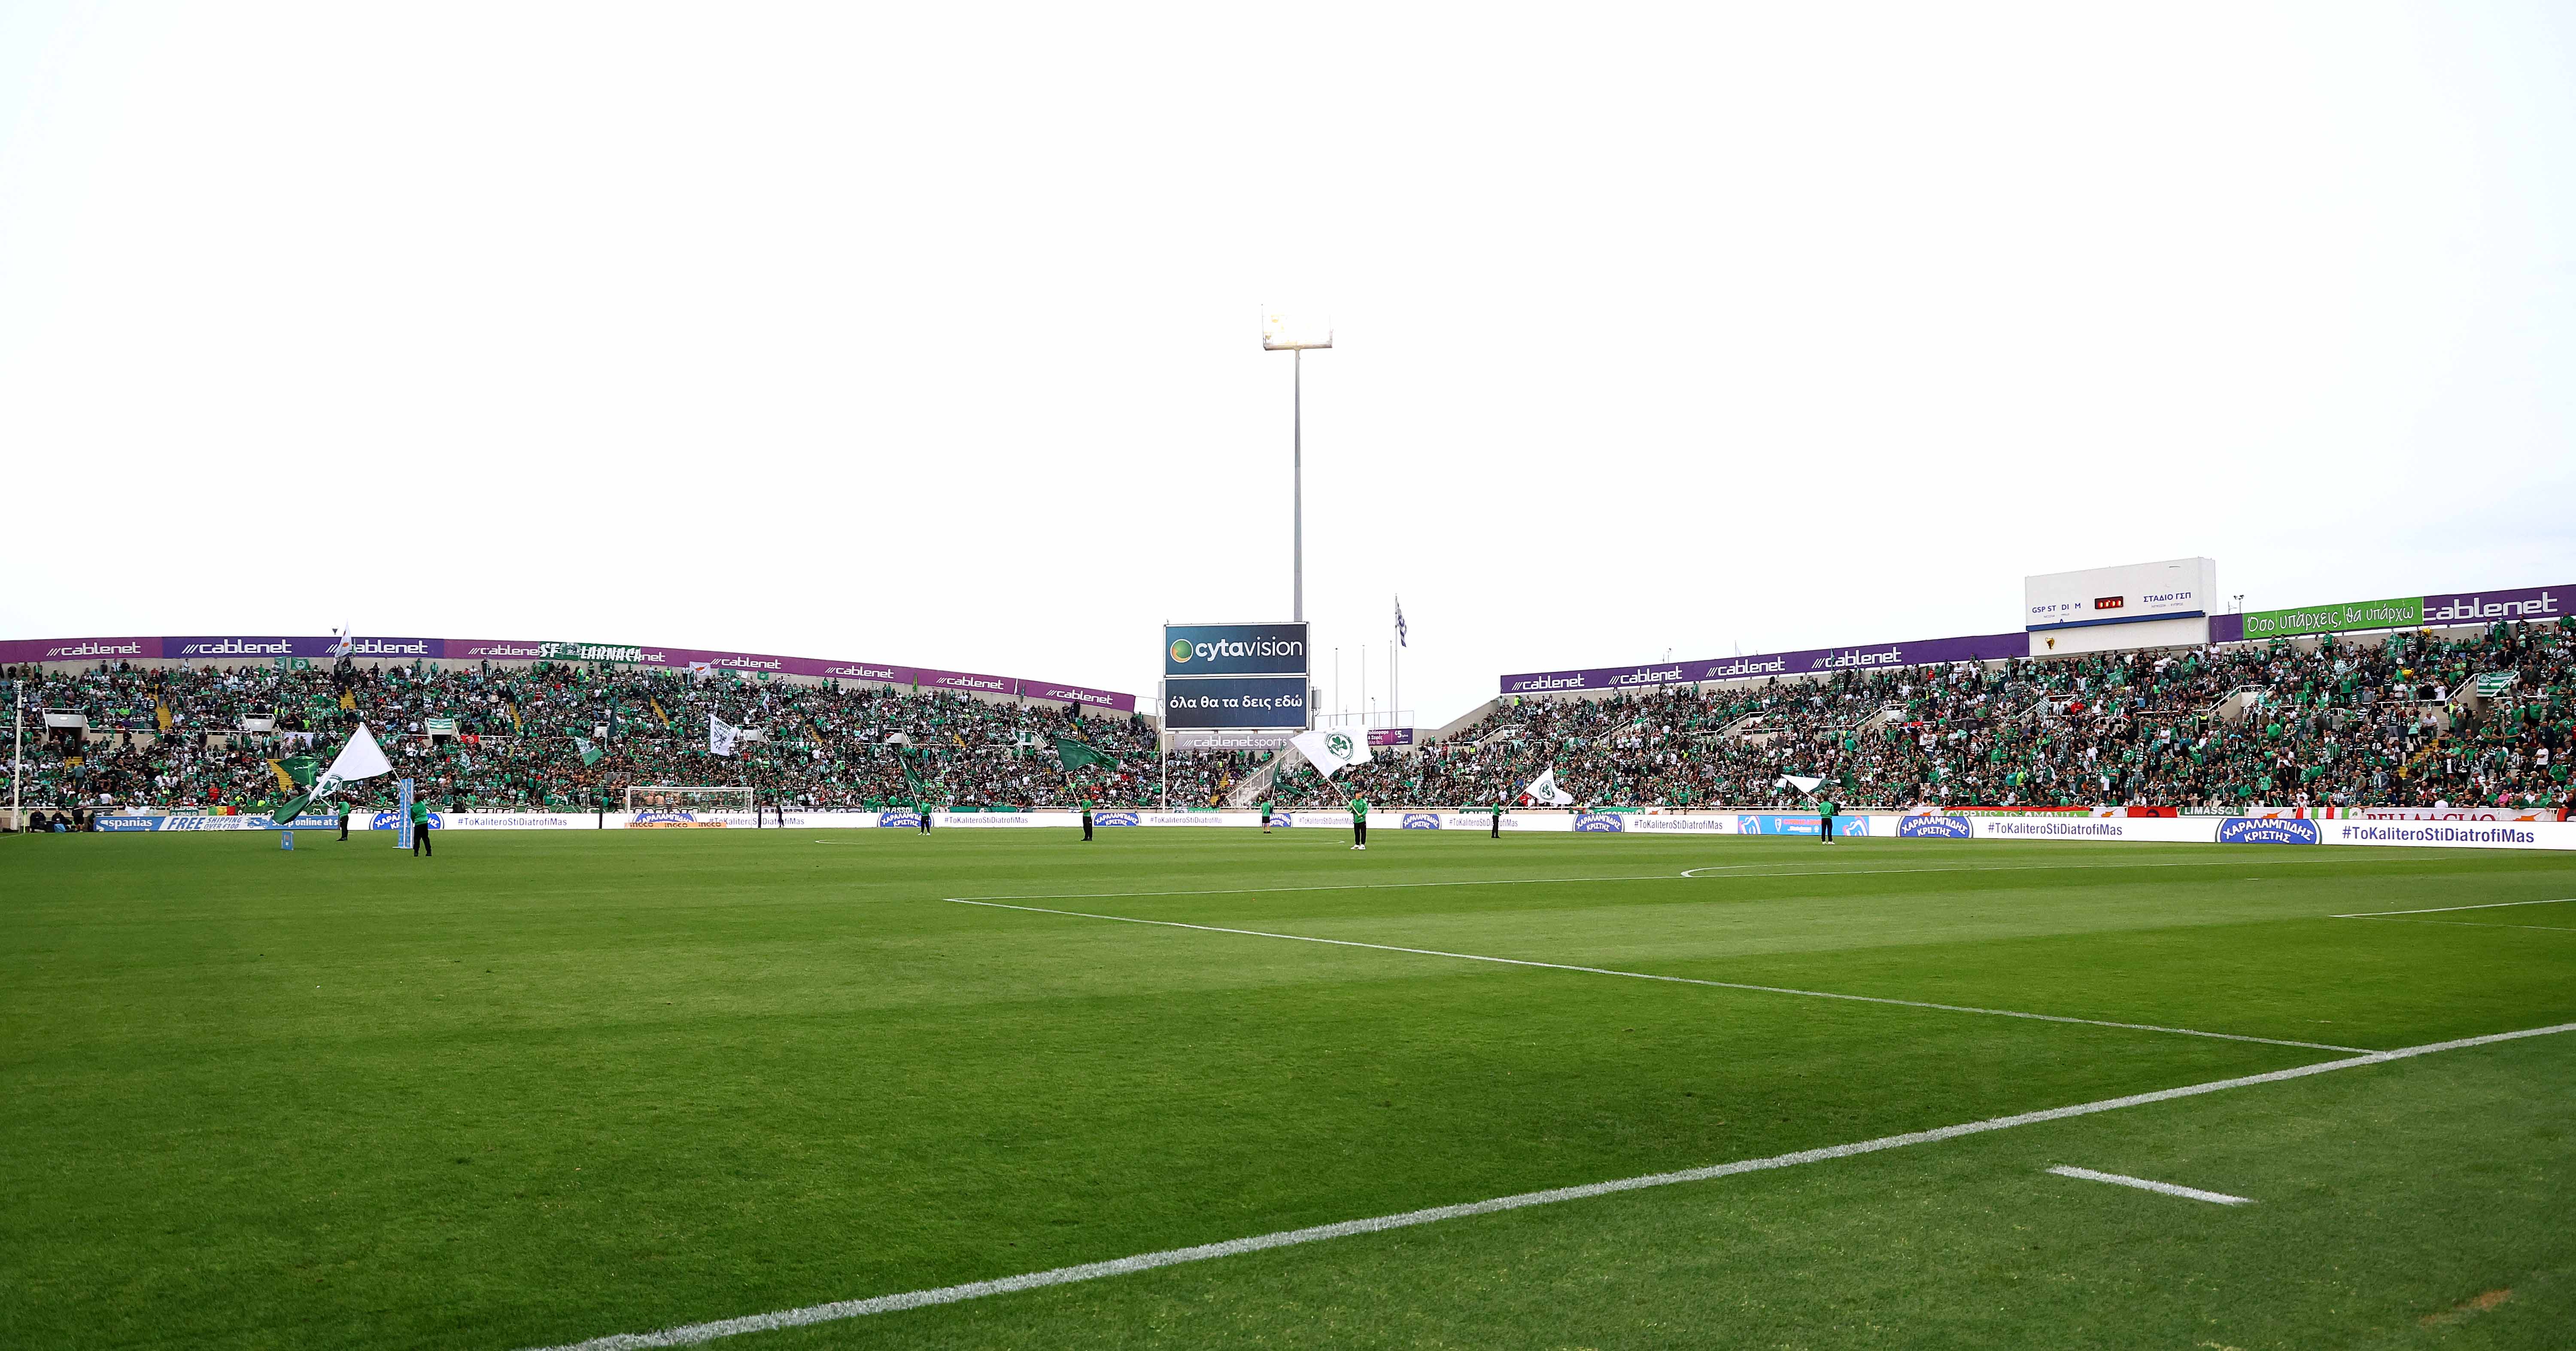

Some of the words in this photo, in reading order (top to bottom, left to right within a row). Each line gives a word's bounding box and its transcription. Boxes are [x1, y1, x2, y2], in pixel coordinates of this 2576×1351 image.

[2346, 607, 2361, 623] θα
[2366, 603, 2413, 623] υπάρχω
[61, 642, 141, 655] cablenet
[199, 640, 292, 654] cablenet
[351, 640, 428, 654] ablenet
[480, 644, 540, 656] cablene
[581, 646, 641, 662] LARNACA
[1195, 636, 1302, 661] cytavision
[721, 658, 781, 670] cablenet
[1825, 647, 1902, 668] cablenet
[836, 666, 894, 679] cablenet
[1718, 656, 1786, 676] cablenet
[1522, 674, 1585, 690] cablenet
[1620, 666, 1683, 684] cablenet
[947, 677, 1004, 690] cablenet
[1057, 690, 1113, 705] cablenet
[1170, 695, 1197, 708] όλα
[1200, 696, 1219, 708] θα
[1222, 698, 1239, 707] τα
[1242, 695, 1271, 710] δεις
[1275, 694, 1303, 707] εδώ
[109, 817, 152, 829] spanias
[167, 817, 206, 829] FREE
[295, 817, 322, 826] online
[458, 817, 567, 826] #ToKaliteroStiDiatrofiMas
[1635, 820, 1722, 829] #ToKaliteroStiDiatrofiMas
[1902, 817, 1968, 835] ΧΑΡΑΛΑΜΠΙΔΗΣ
[1917, 827, 1951, 837] ΚΡΙΣΤΗΣ
[1989, 823, 2122, 835] #ToKaliteroStiDiatrofiMas
[2223, 819, 2314, 841] ΧΑΡΑΛΑΜΠΙΔΗΣ
[2342, 826, 2534, 843] #ToKaliteroStiDiatrofiMas
[2244, 831, 2291, 843] ΚΡΙΣΤΗΣ
